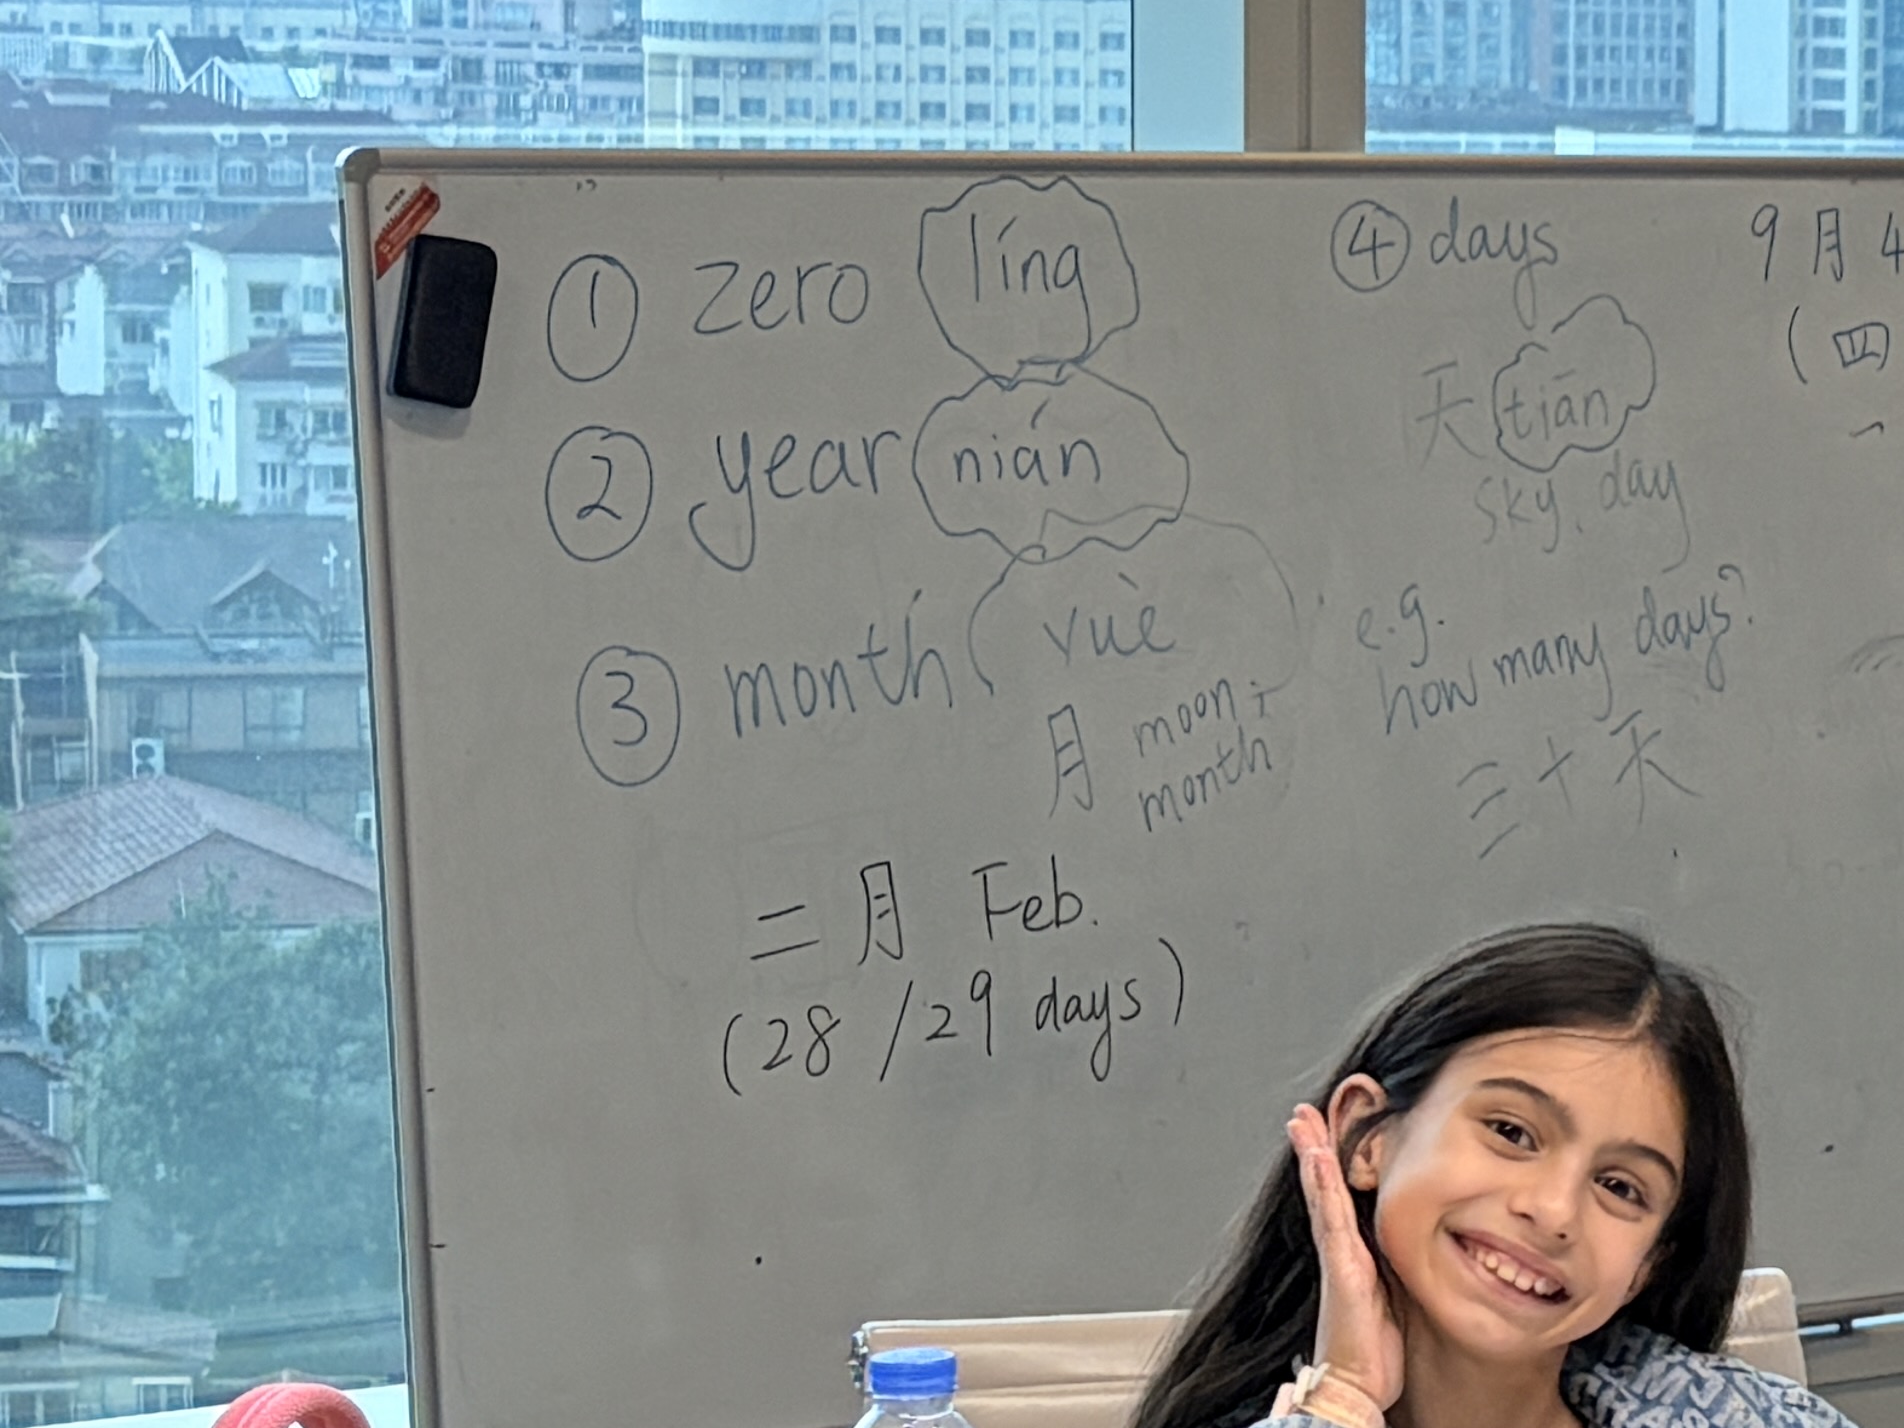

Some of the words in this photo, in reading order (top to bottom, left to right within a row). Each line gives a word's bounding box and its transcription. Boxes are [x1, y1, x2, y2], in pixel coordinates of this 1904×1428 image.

[694, 261, 870, 333] zero
[1430, 195, 1557, 330] days
[689, 430, 900, 570] year
[1600, 449, 1691, 573] day
[724, 588, 953, 737] month
[1378, 658, 1477, 735] how
[1493, 622, 1613, 722] many
[1048, 704, 1093, 818] 月
[1139, 725, 1271, 832] month
